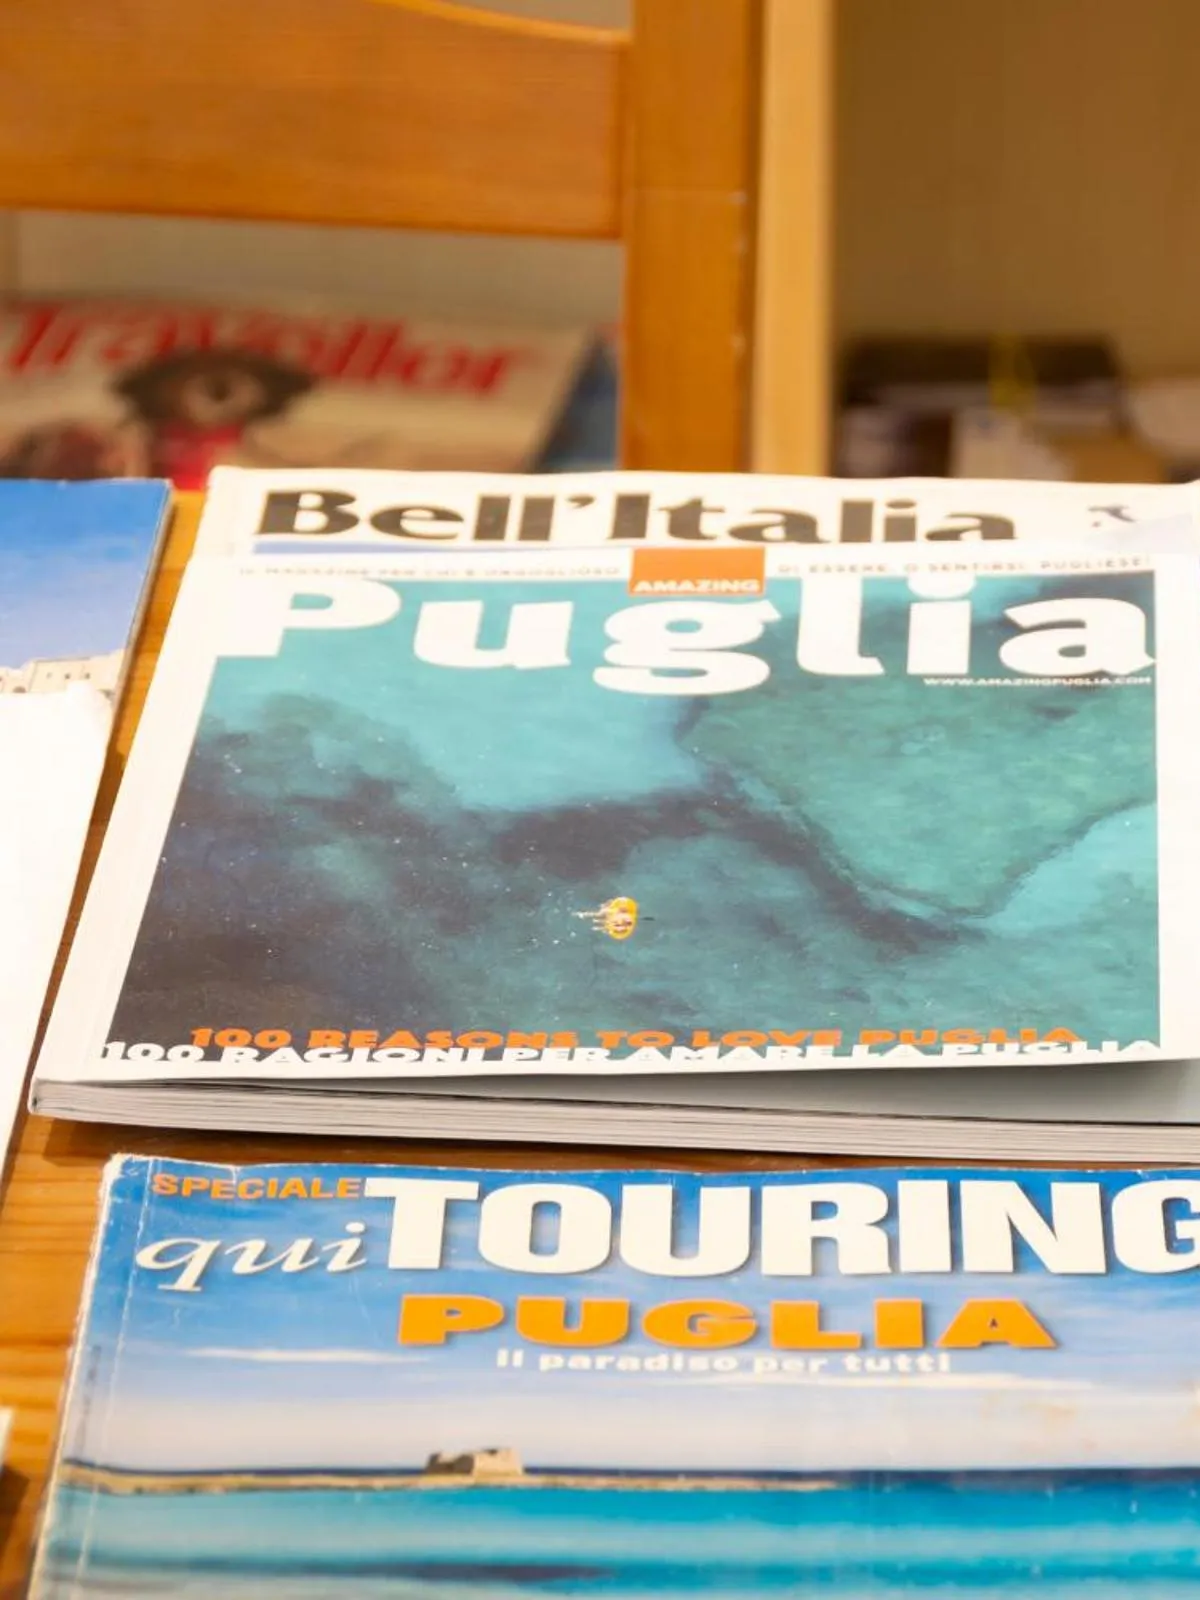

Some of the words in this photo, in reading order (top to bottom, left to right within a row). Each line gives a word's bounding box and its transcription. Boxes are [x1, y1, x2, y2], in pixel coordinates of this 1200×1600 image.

[254, 490, 1017, 543] Bell'Italia
[634, 578, 760, 593] AMAZING
[213, 574, 1157, 694] Puglia
[190, 1028, 292, 1048] 100
[308, 1030, 579, 1049] REASONS
[595, 1030, 675, 1047] TO
[691, 1030, 842, 1047] LOVE
[860, 1027, 1084, 1045] PUGLIA
[101, 1040, 205, 1063] 100
[220, 1046, 485, 1064] RAGIONI
[502, 1045, 613, 1063] PER
[615, 1045, 847, 1062] AMARE
[852, 1043, 934, 1059] LA
[942, 1040, 1162, 1057] PUGLIA
[151, 1173, 363, 1200] SPECIALE
[135, 1221, 370, 1292] qui
[397, 1294, 1058, 1348] PUGLIA
[496, 1349, 524, 1368] Il
[539, 1352, 739, 1373] paradiso
[753, 1354, 829, 1375] per
[842, 1353, 951, 1374] tutti
